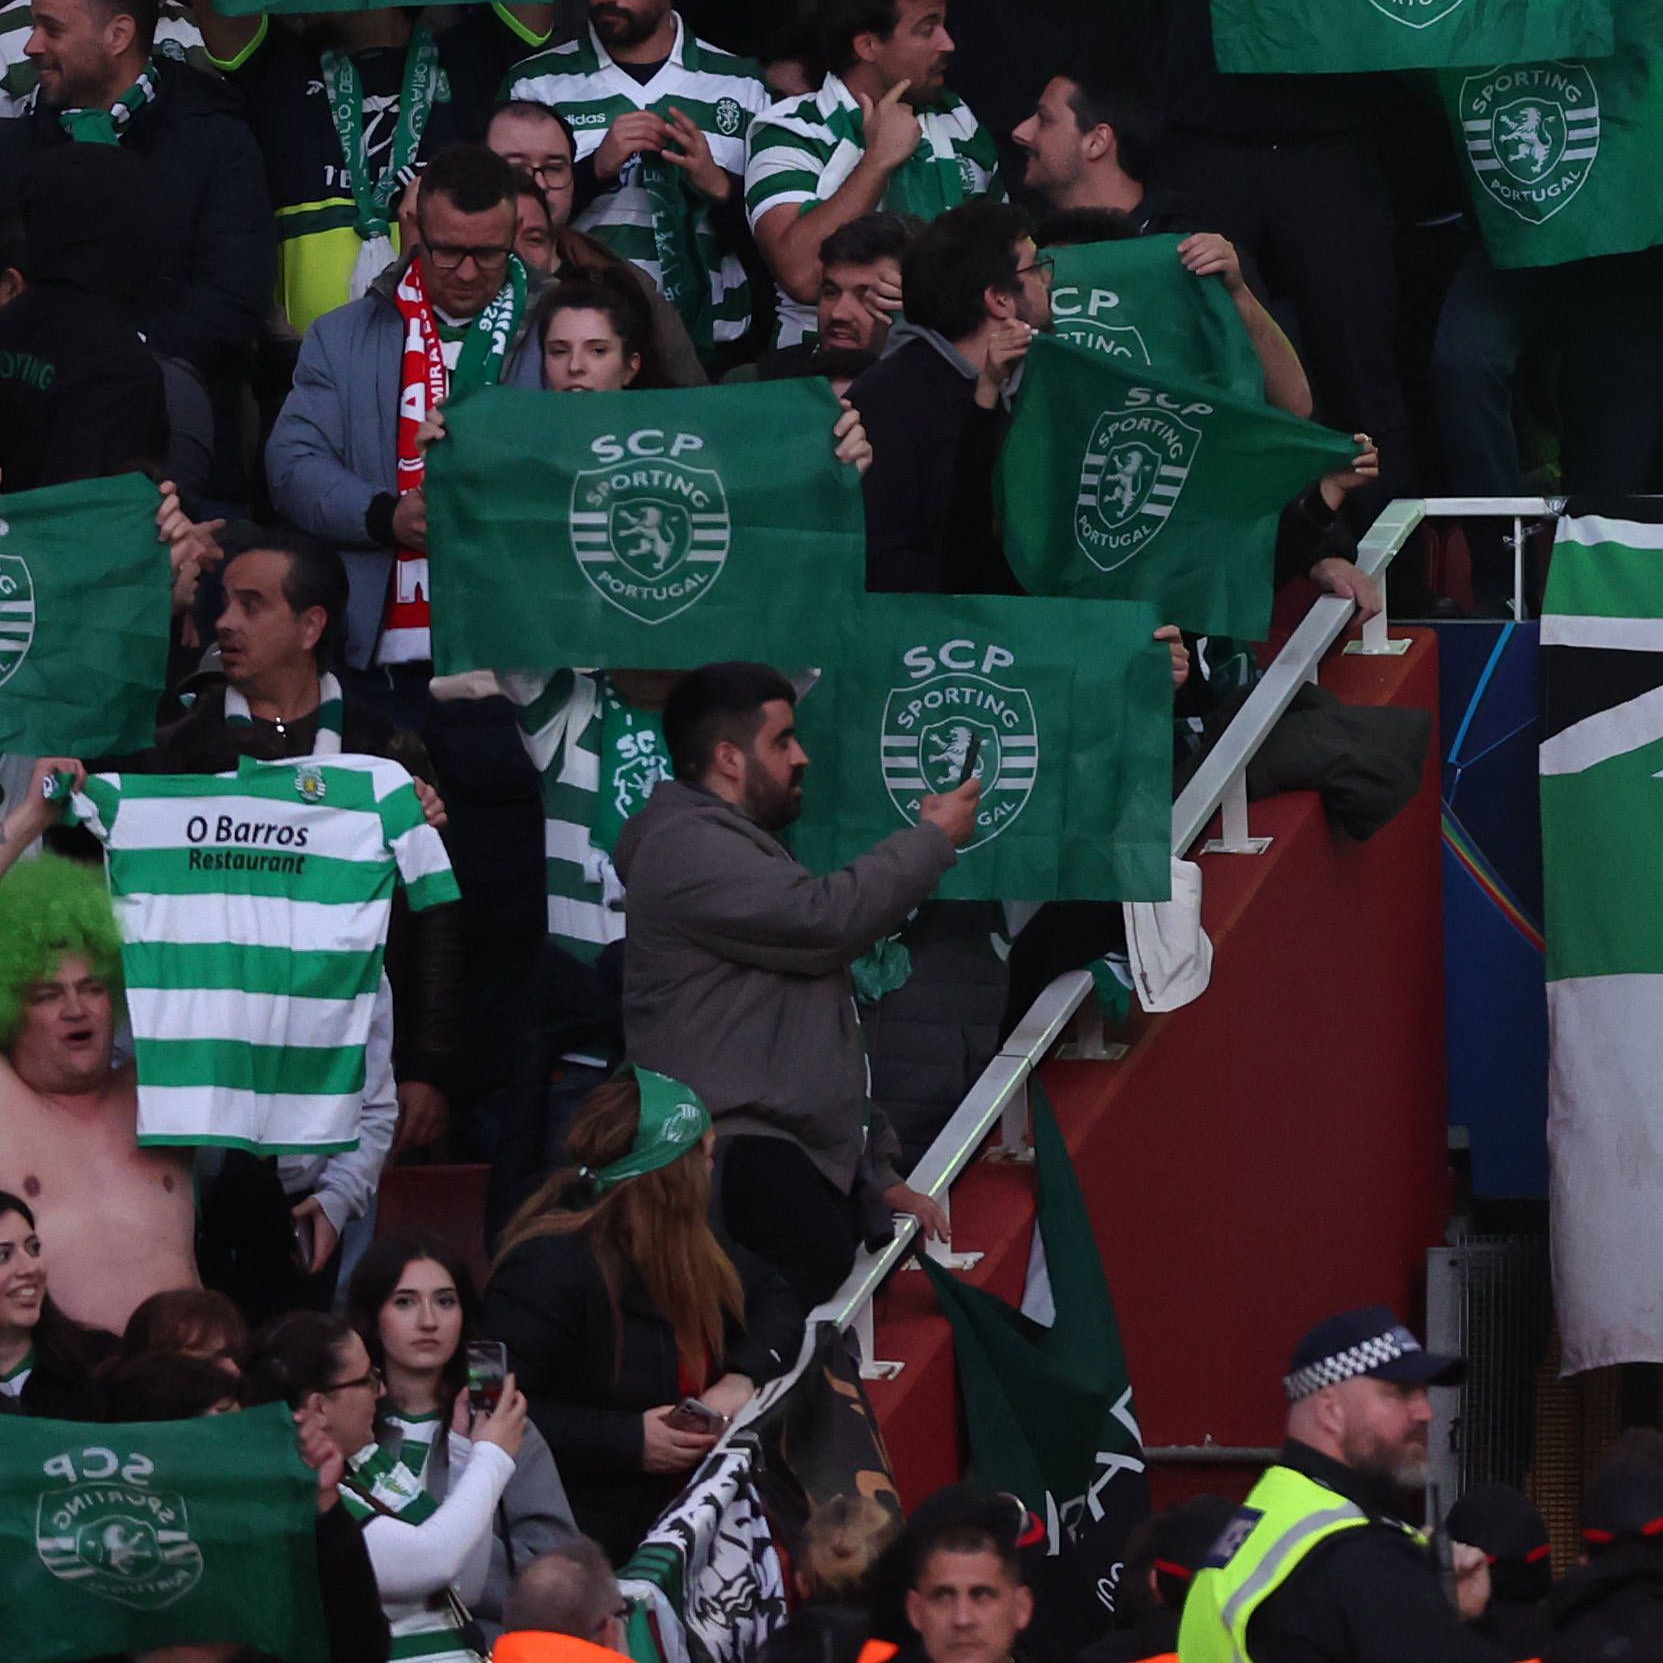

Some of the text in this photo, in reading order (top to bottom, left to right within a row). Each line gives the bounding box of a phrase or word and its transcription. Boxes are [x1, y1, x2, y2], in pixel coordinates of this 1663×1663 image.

[1472, 69, 1582, 116] SPORTING
[1491, 167, 1582, 205] PORTUGAL
[1050, 288, 1120, 318] CP
[1124, 387, 1214, 418] SCP
[589, 430, 704, 463] SCP
[1097, 416, 1182, 461] SPORTING
[586, 470, 711, 509] SPORTING
[1078, 514, 1152, 550] PORTUGAL
[598, 570, 711, 600] PORTUGAL
[903, 640, 1014, 679] SCP
[898, 687, 1020, 730] SPORTING
[186, 814, 309, 849] O Barros
[188, 849, 306, 876] Restaurant
